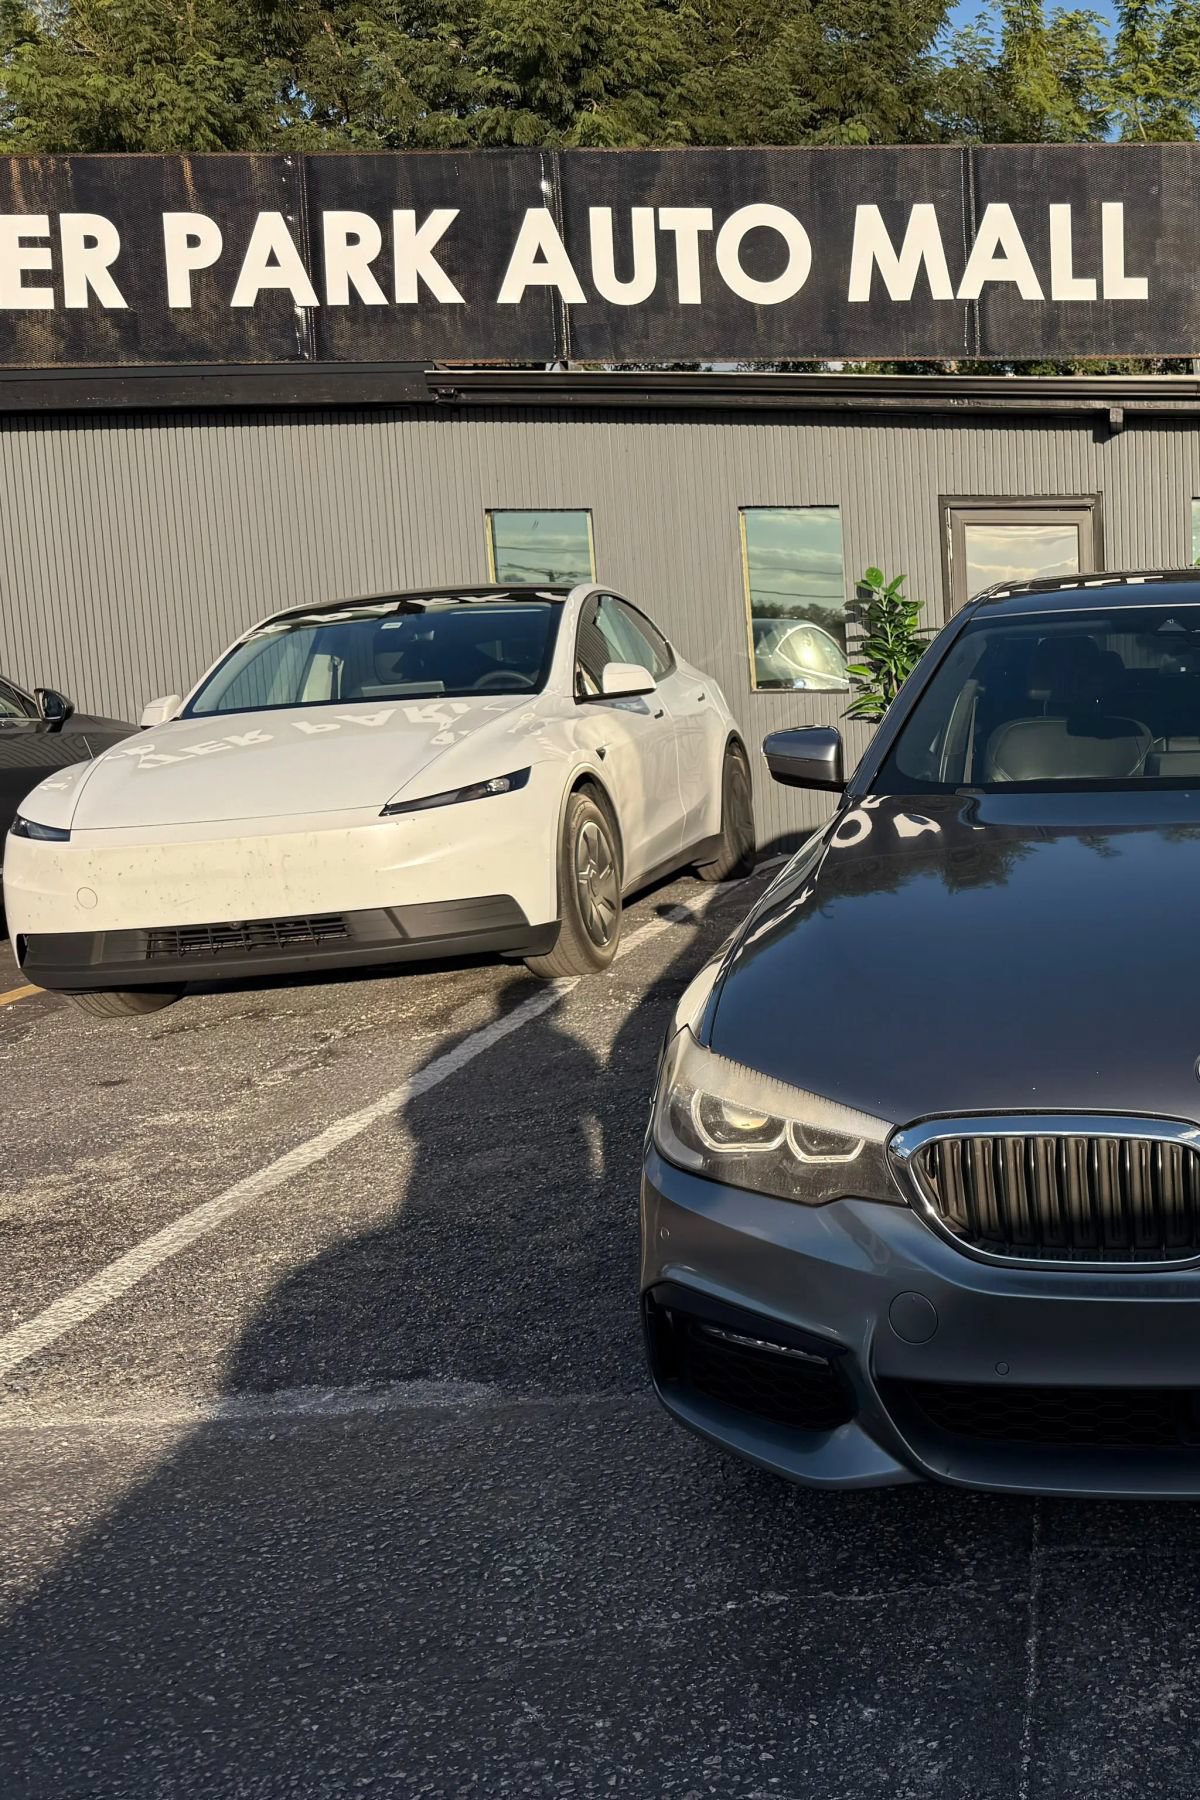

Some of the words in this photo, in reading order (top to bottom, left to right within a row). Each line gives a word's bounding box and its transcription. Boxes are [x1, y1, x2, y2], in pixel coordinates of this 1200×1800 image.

[0, 213, 129, 309] ER
[162, 209, 466, 308] PARK
[496, 203, 812, 305] AUTO
[848, 202, 1149, 302] MALL
